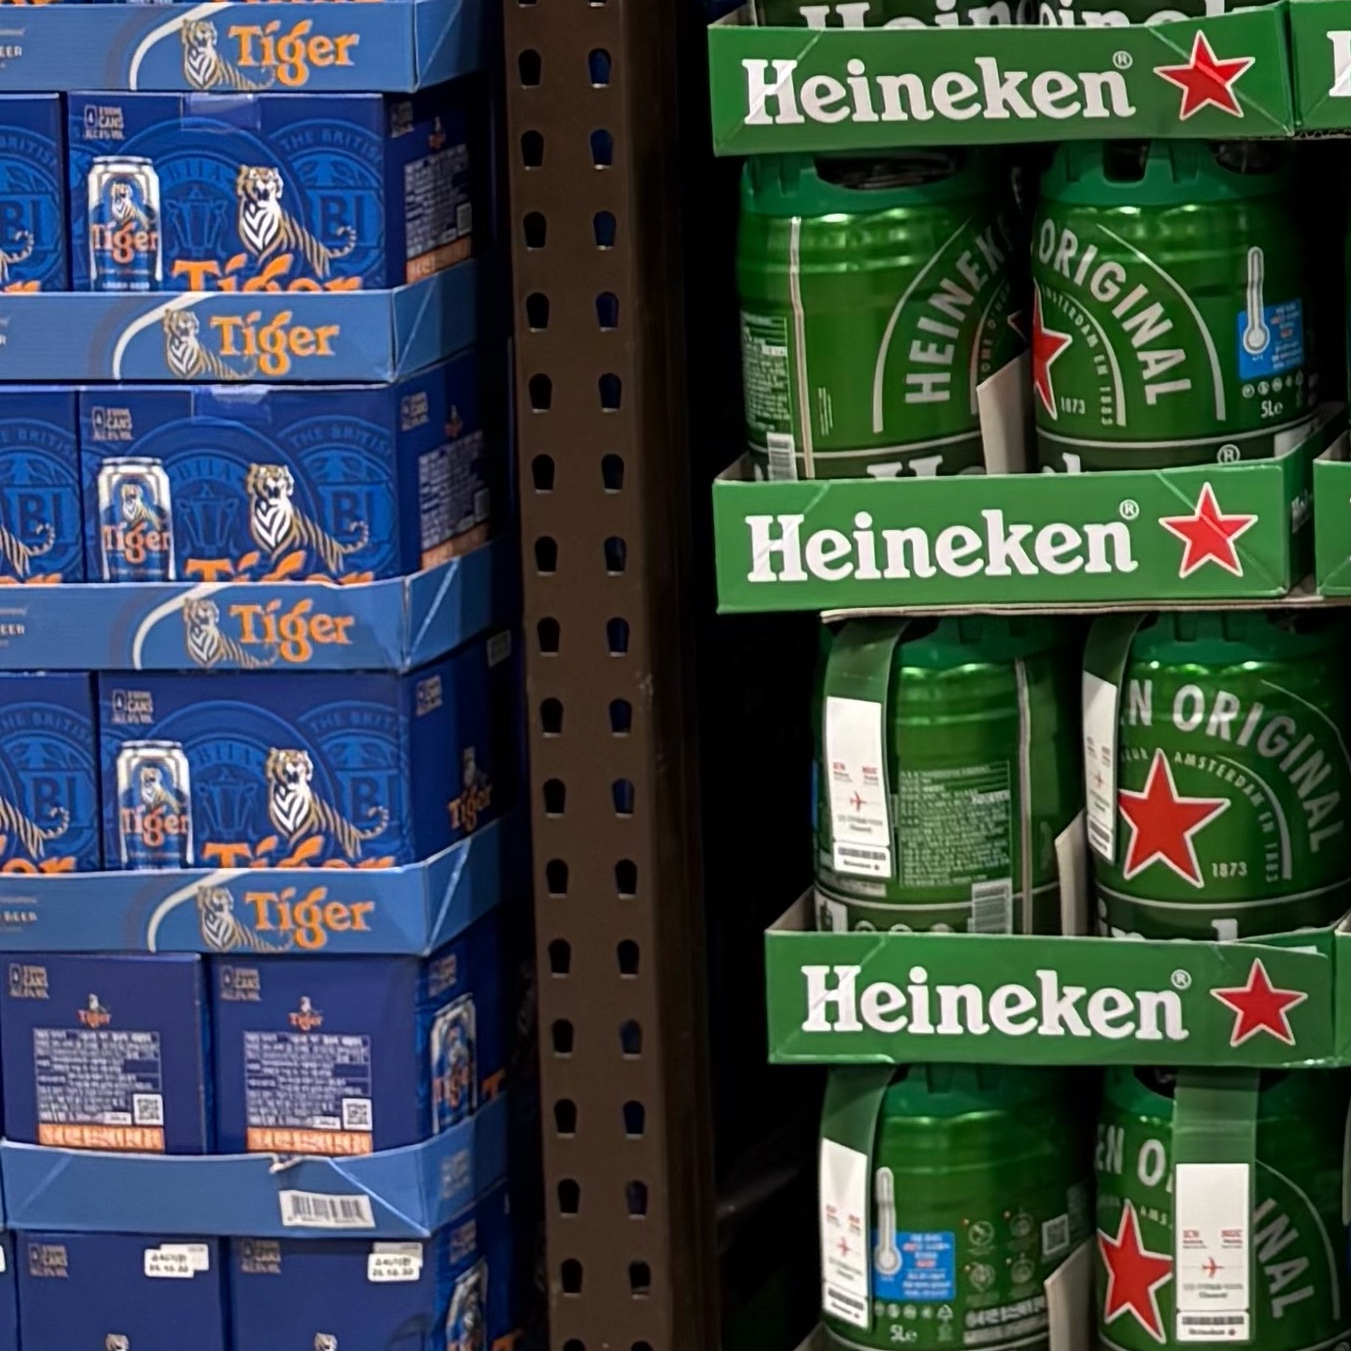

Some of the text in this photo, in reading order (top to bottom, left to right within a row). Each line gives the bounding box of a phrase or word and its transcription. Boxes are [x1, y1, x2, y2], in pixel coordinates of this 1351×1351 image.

[228, 18, 359, 87] Tiger
[741, 57, 1136, 126] Heineken
[91, 222, 158, 264] Tiger
[210, 310, 340, 376] Tiger
[1038, 219, 1192, 405] ORIGINAL
[1061, 397, 1085, 414] 1873
[103, 521, 169, 564] Tiger
[745, 510, 1138, 582] Heineken
[228, 598, 354, 663] Tiger
[1173, 684, 1344, 853] ORIGINAL
[121, 804, 189, 847] Tiger
[448, 787, 492, 832] Tiger
[1212, 862, 1247, 877] 1873
[244, 886, 375, 948] Tiger
[801, 964, 1188, 1039] Heineken
